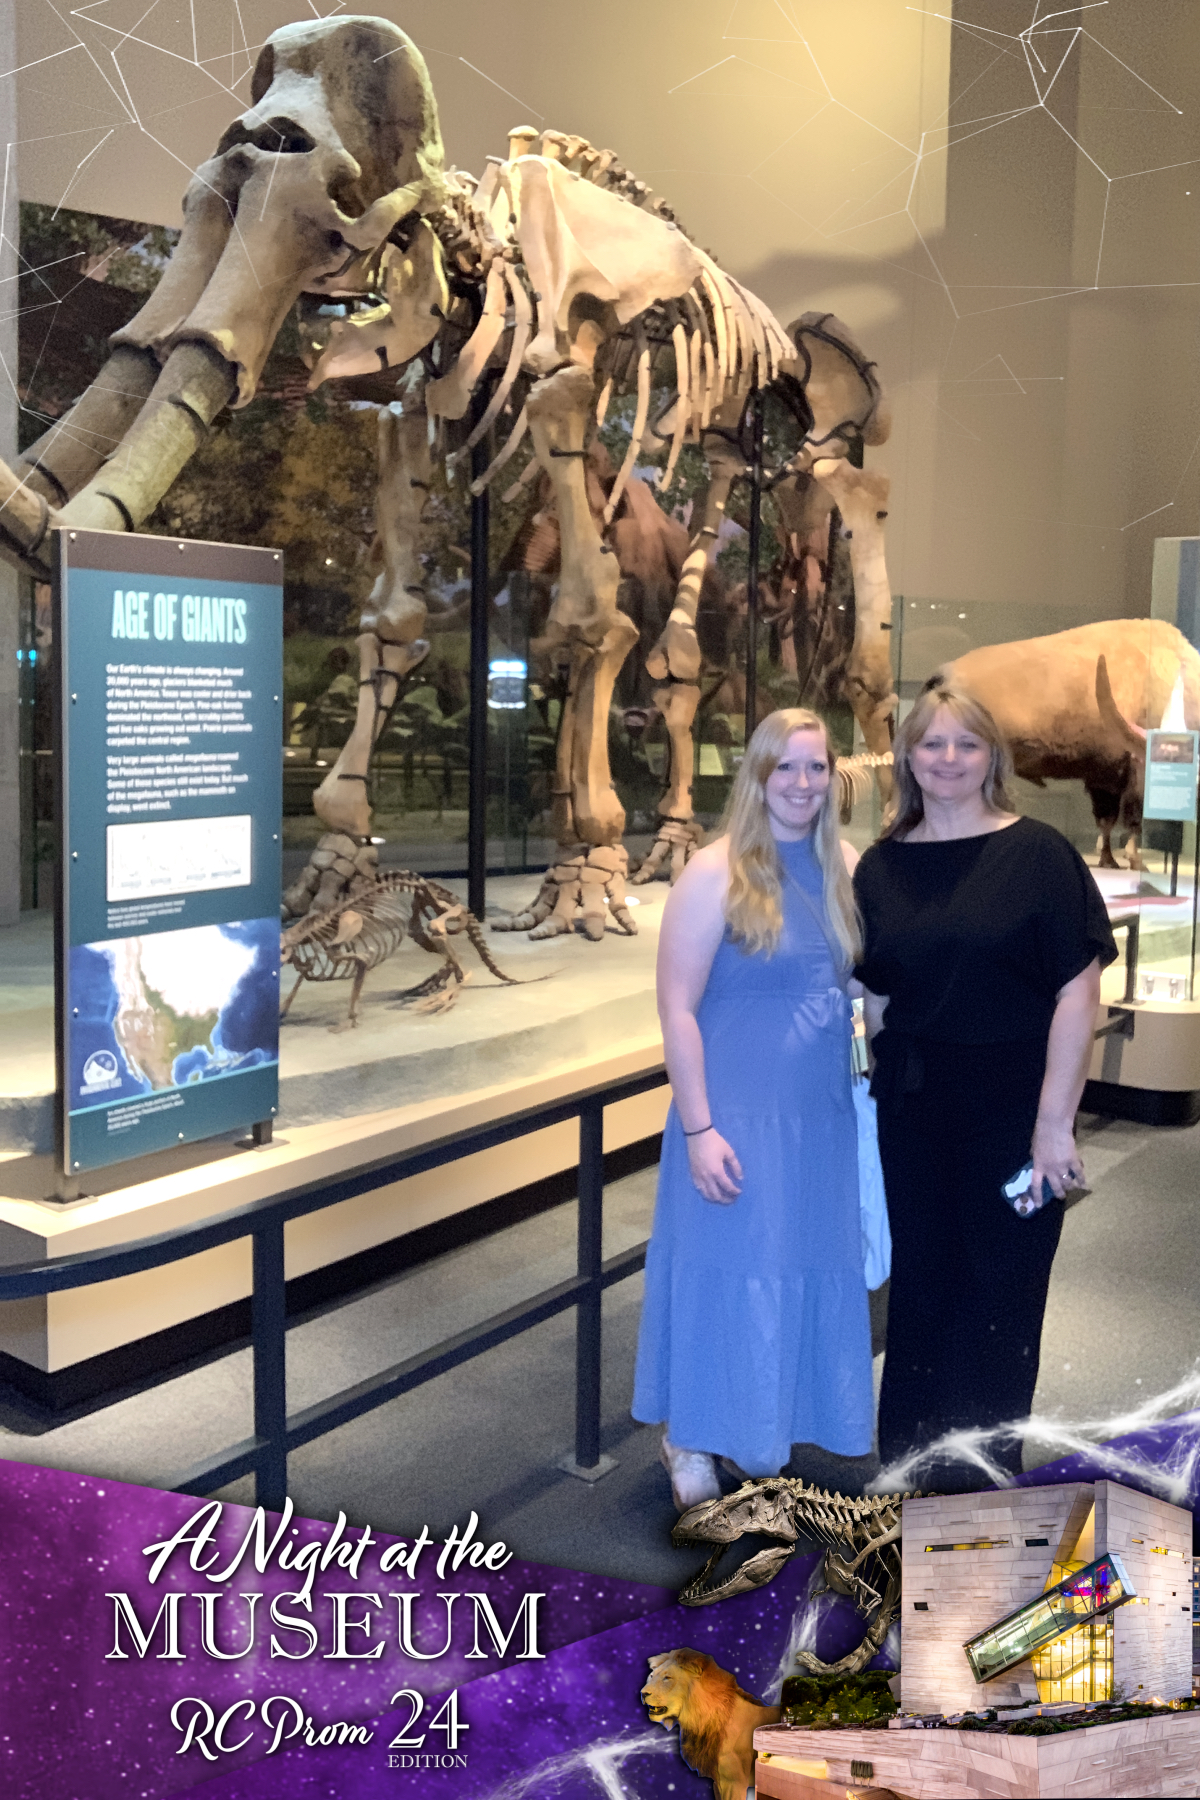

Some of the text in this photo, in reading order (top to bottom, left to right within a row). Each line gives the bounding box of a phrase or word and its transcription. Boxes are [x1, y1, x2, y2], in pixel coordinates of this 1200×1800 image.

[112, 590, 247, 644] AGE OF GIANTS
